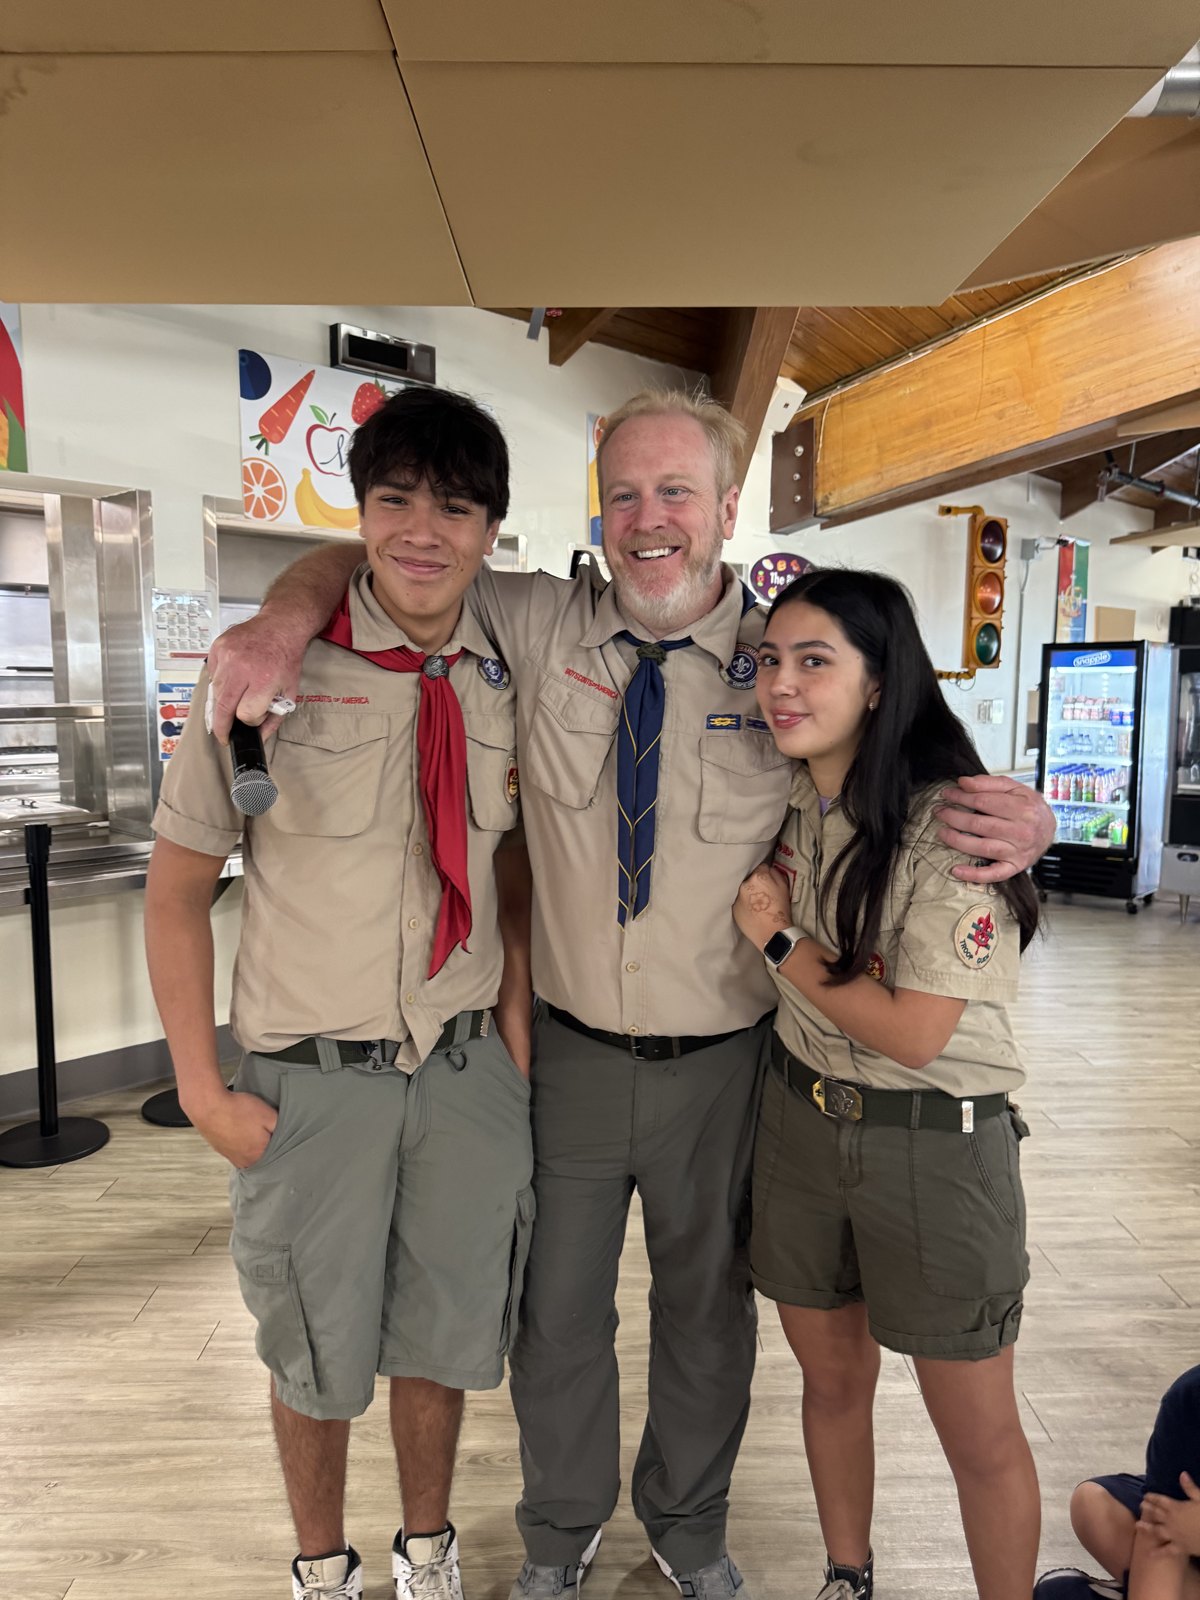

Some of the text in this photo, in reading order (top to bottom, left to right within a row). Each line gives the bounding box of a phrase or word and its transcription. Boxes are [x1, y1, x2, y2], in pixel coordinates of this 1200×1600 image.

[769, 571, 785, 586] The
[305, 694, 332, 703] SCOUTS
[341, 696, 369, 704] AMERICA
[597, 683, 619, 700] AMERICA
[960, 938, 974, 960] TROOP
